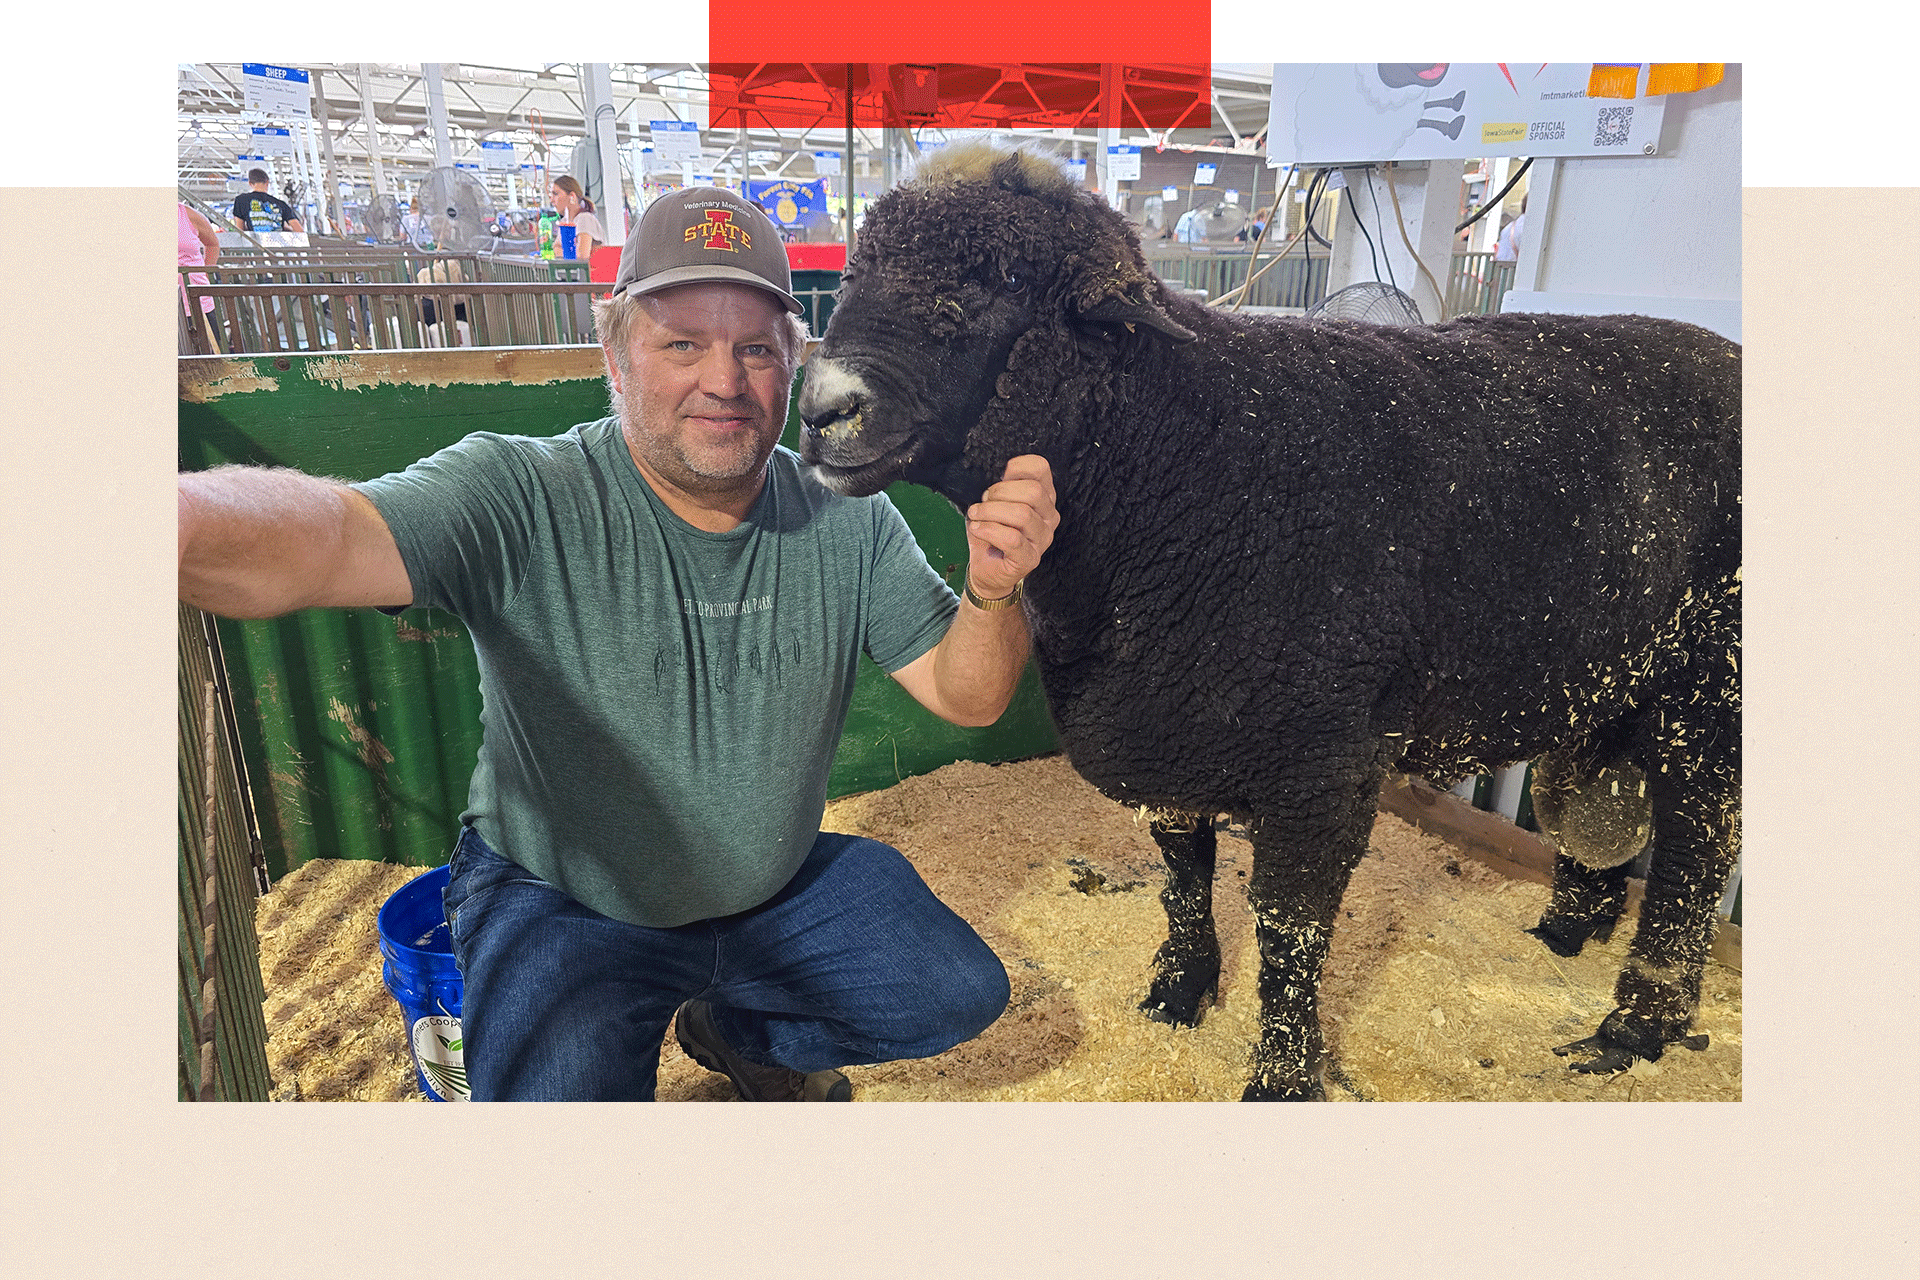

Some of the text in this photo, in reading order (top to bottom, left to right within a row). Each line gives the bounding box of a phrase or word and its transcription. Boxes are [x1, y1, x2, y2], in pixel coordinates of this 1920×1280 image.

[265, 67, 287, 79] SHEEP
[1540, 89, 1595, 100] imtmarketi
[1530, 121, 1566, 132] OFFICIAL
[1528, 130, 1566, 141] SPONSOR
[683, 200, 720, 210] Veterinary
[721, 201, 752, 218] Medicine
[684, 221, 752, 251] STATE
[704, 599, 752, 618] PROVINCAL
[752, 595, 773, 612] PARK
[414, 1017, 460, 1049] Farmers Coop
